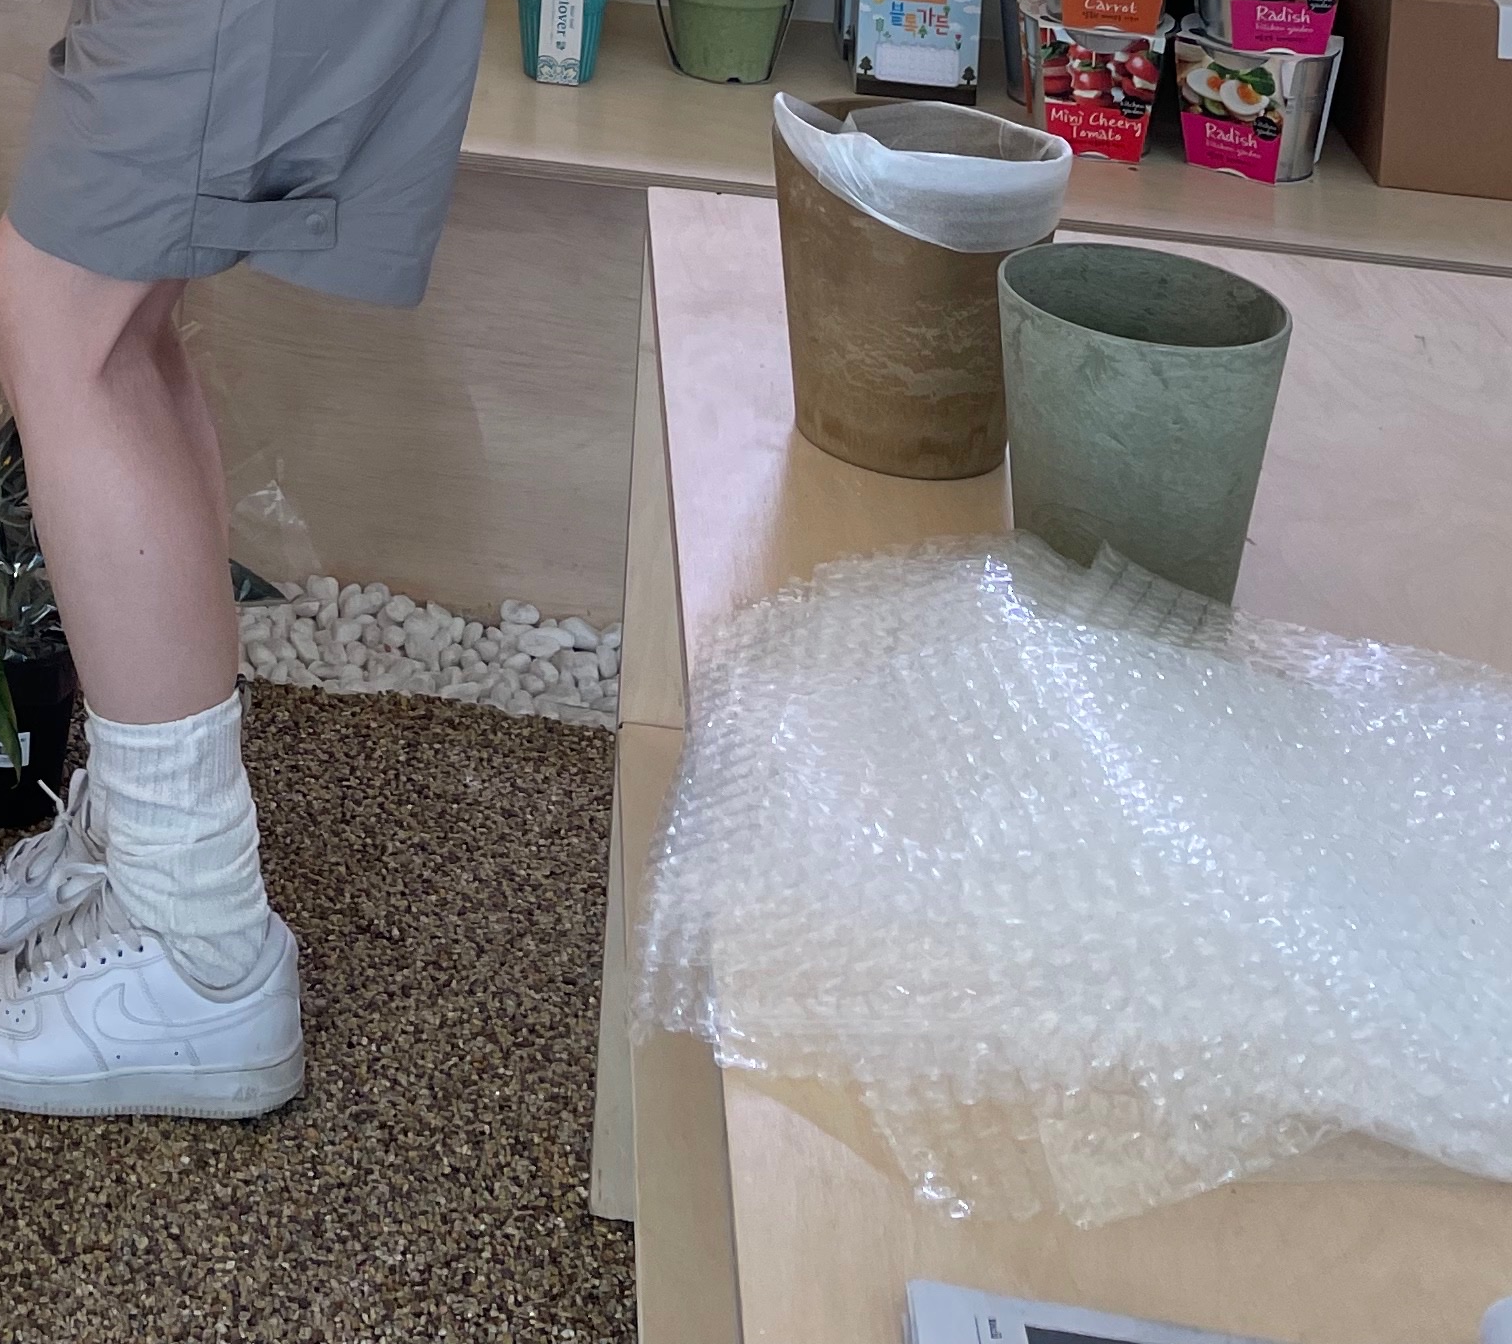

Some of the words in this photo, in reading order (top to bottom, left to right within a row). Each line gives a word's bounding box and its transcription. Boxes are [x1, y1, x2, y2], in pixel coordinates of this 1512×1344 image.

[1255, 5, 1310, 24] Radish
[1050, 107, 1084, 124] Mini
[1089, 112, 1142, 137] Cheery
[1070, 123, 1122, 141] Tomato
[1205, 122, 1258, 149] Radish
